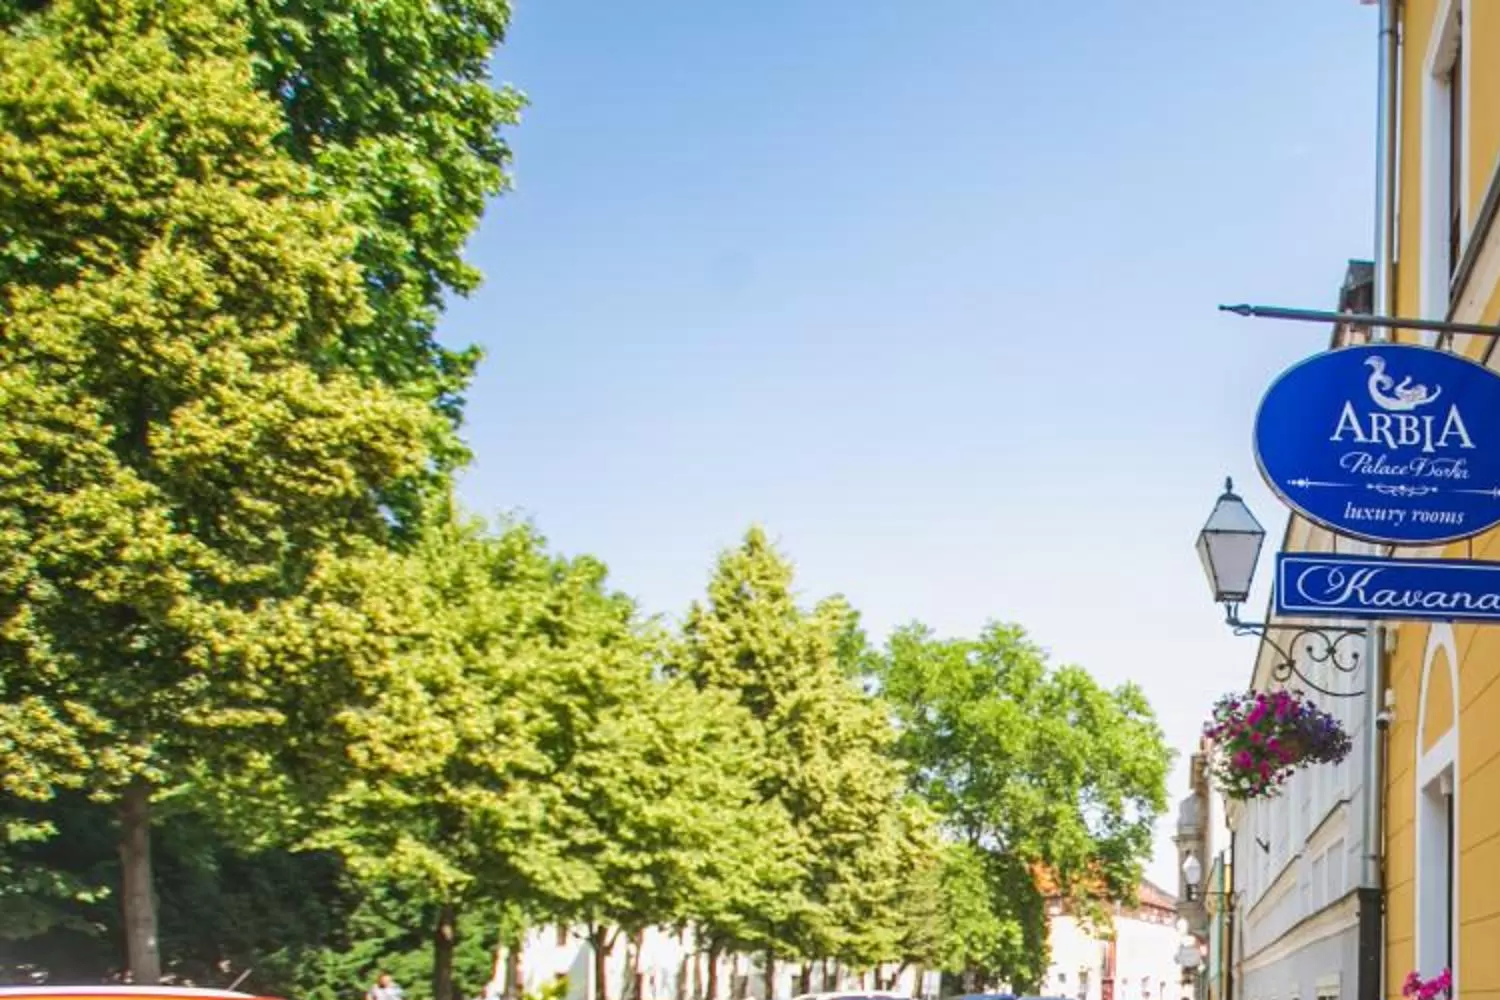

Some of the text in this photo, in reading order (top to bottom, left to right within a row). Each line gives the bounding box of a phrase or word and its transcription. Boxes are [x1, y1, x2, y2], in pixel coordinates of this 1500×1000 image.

[1329, 399, 1477, 453] ARBIA
[1339, 451, 1470, 480] Palace Dorka
[1343, 500, 1466, 527] luxury rooms
